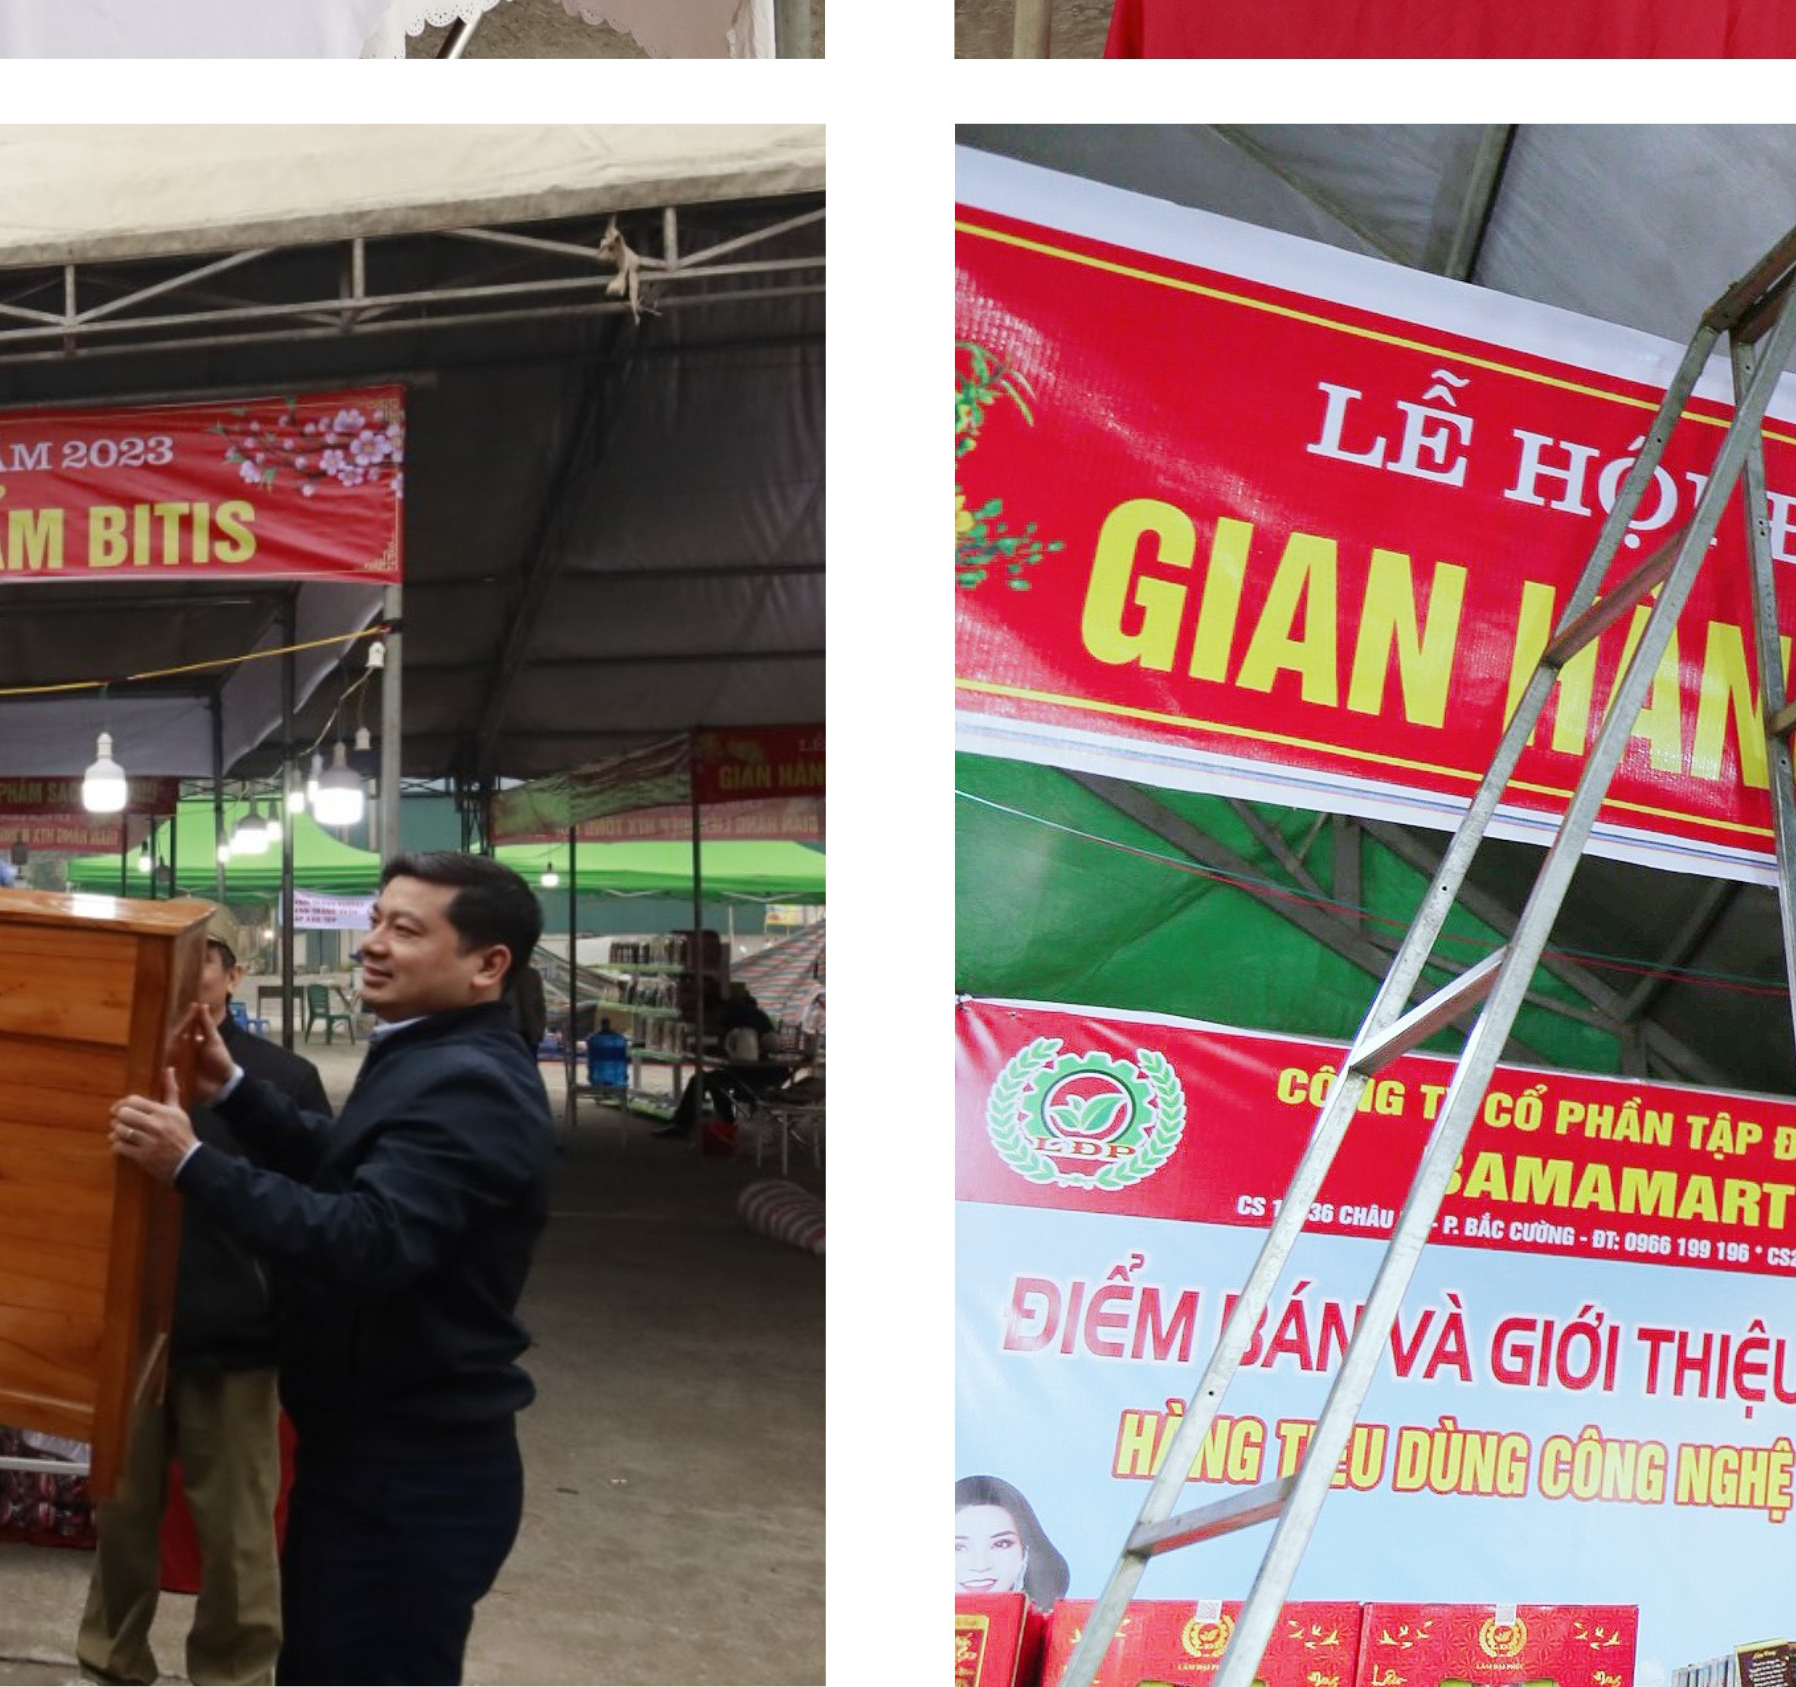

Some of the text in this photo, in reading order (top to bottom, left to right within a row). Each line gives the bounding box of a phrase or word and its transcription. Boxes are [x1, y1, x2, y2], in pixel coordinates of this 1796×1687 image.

[60, 434, 175, 469] 2023
[1307, 368, 1473, 488] LỄ
[88, 498, 258, 569] BITIS
[1080, 496, 1468, 730] GIAN
[719, 762, 772, 790] GIAN
[1034, 1136, 1137, 1160] LĐP
[1485, 1083, 1543, 1133] CỔ
[1556, 1095, 1674, 1148] PHẦN
[1686, 1110, 1764, 1163] TẬP
[1237, 1195, 1266, 1216] CS
[1339, 1203, 1393, 1230] CHÂU
[1442, 1216, 1459, 1238] P.
[1463, 1216, 1506, 1241] BẮC
[1508, 1218, 1575, 1248] CƯỜNG
[1592, 1228, 1622, 1252] ĐT:
[1624, 1232, 1671, 1257] 0966
[1676, 1236, 1711, 1259] 199
[1715, 1239, 1751, 1262] 196
[1001, 1250, 1199, 1363] ĐIỂM
[1491, 1301, 1620, 1392] GIỚI
[1394, 1414, 1796, 1524] DÙNG CÔNG NGHỆ
